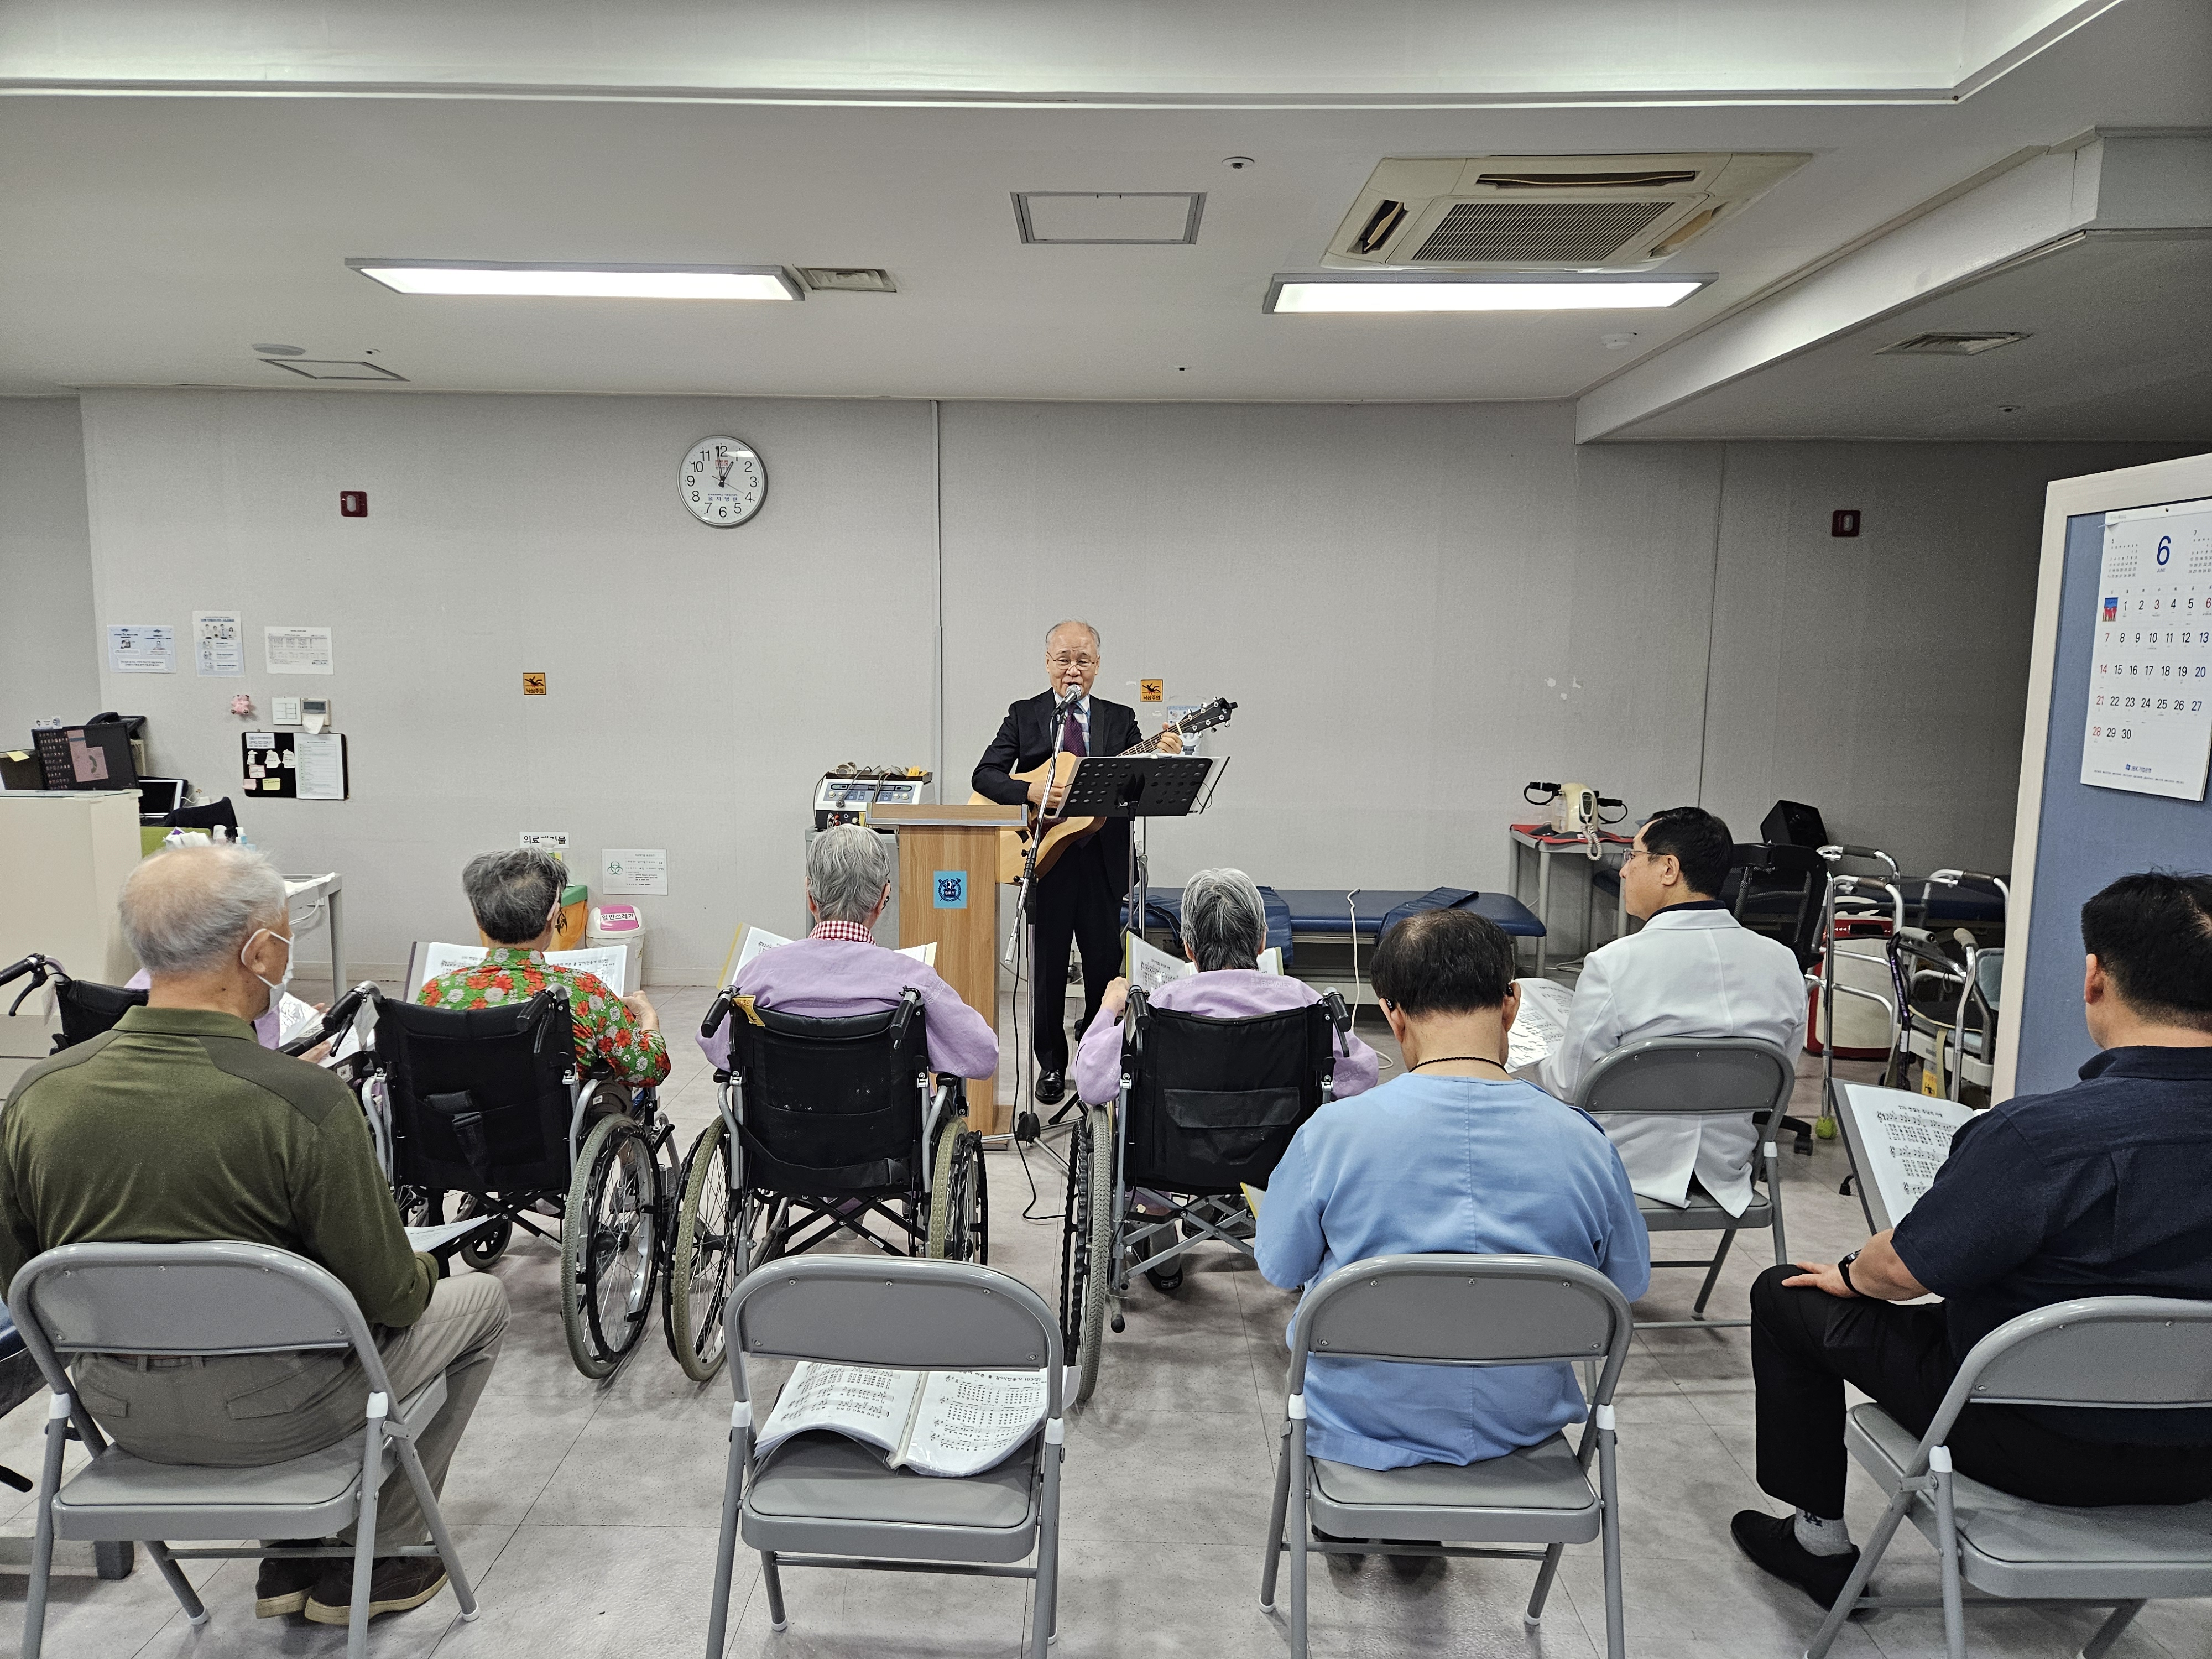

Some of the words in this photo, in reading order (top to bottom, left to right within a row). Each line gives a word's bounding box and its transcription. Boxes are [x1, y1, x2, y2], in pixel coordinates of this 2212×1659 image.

[700, 450, 710, 461] 11
[716, 446, 728, 457] 12
[691, 461, 703, 472] 10
[744, 461, 752, 472] 2
[687, 476, 695, 487] 9
[749, 476, 757, 487] 3
[692, 491, 700, 502] 8
[745, 492, 753, 503] 4
[705, 503, 712, 513] 7
[719, 507, 727, 518] 6
[734, 503, 742, 514] 5
[2157, 536, 2171, 565] 6
[2124, 601, 2127, 611] 1
[2139, 600, 2144, 610] 2
[2154, 600, 2159, 609] 3
[2171, 599, 2176, 608] 4
[2188, 598, 2194, 608] 5
[2206, 598, 2211, 608] 6
[2105, 633, 2110, 642] 7
[2120, 633, 2125, 643] 8
[2136, 633, 2140, 643] 9
[2149, 632, 2157, 643] 10
[2166, 633, 2173, 643] 11
[2182, 632, 2190, 643] 12
[2200, 632, 2209, 643] 13
[2100, 664, 2107, 674] 14
[2115, 665, 2122, 674] 15
[2130, 665, 2137, 675] 16
[2145, 666, 2153, 675] 17
[2162, 666, 2170, 676] 18
[2178, 666, 2187, 676] 19
[2195, 667, 2206, 677] 20
[2096, 696, 2104, 705] 21
[2110, 696, 2119, 706] 22
[2125, 697, 2135, 707] 23
[2141, 698, 2150, 708] 24
[2157, 699, 2167, 709] 25
[2174, 700, 2184, 711] 26
[2192, 701, 2202, 711] 27
[2093, 726, 2101, 736] 28
[2106, 728, 2116, 737] 29
[2121, 729, 2131, 739] 30
[523, 836, 566, 844] 의료물
